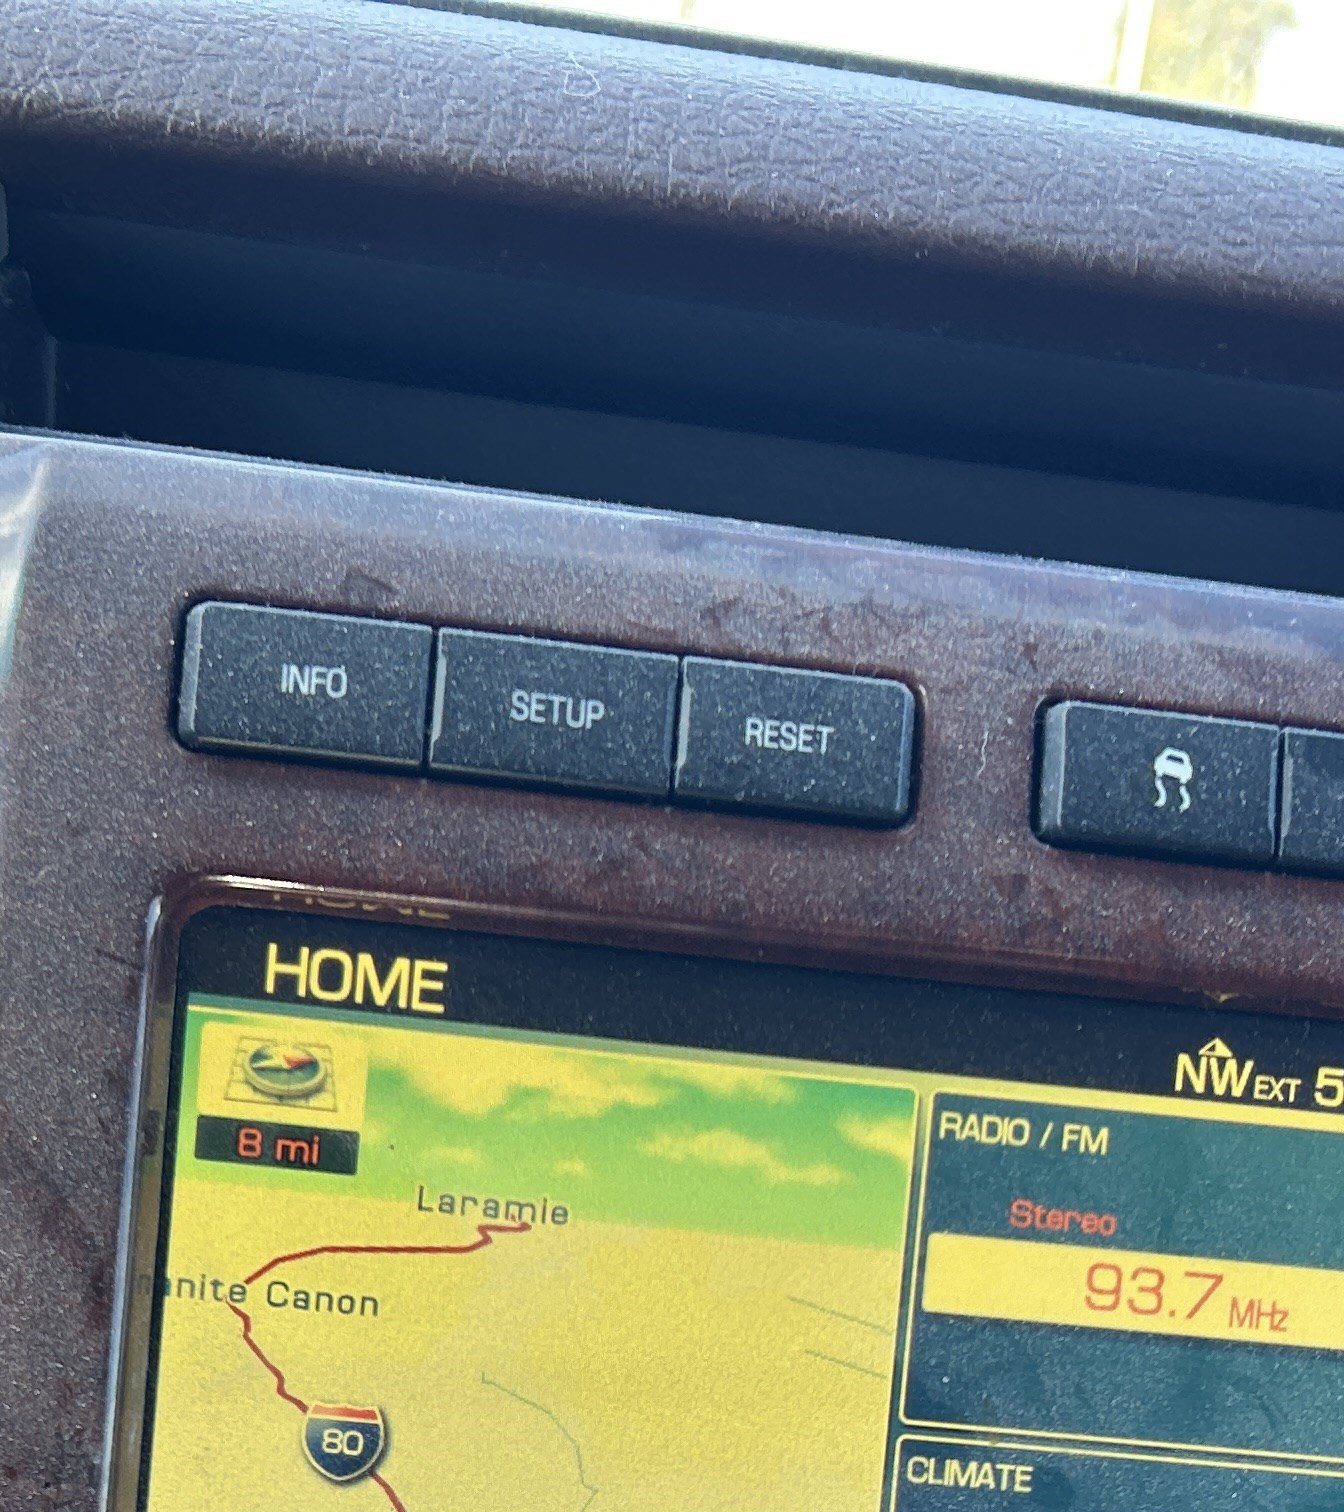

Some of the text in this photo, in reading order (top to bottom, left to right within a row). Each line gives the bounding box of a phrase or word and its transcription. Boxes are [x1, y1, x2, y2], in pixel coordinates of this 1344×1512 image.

[280, 664, 347, 699] INFO
[510, 691, 605, 731] SETUP
[744, 717, 833, 755] RESET
[265, 942, 449, 1014] HOME
[1174, 1053, 1254, 1099] NW
[1253, 1074, 1302, 1103] EXT
[237, 1128, 320, 1165] 8 mi
[939, 1111, 1030, 1148] RADIO
[1061, 1125, 1109, 1156] FM
[416, 1185, 569, 1226] Laramie
[1009, 1199, 1118, 1236] Stereo
[266, 1280, 380, 1317] Canon
[1084, 1262, 1290, 1334] 93.7 MHz
[321, 1428, 365, 1456] 80
[906, 1455, 1033, 1493] CLIMATE
